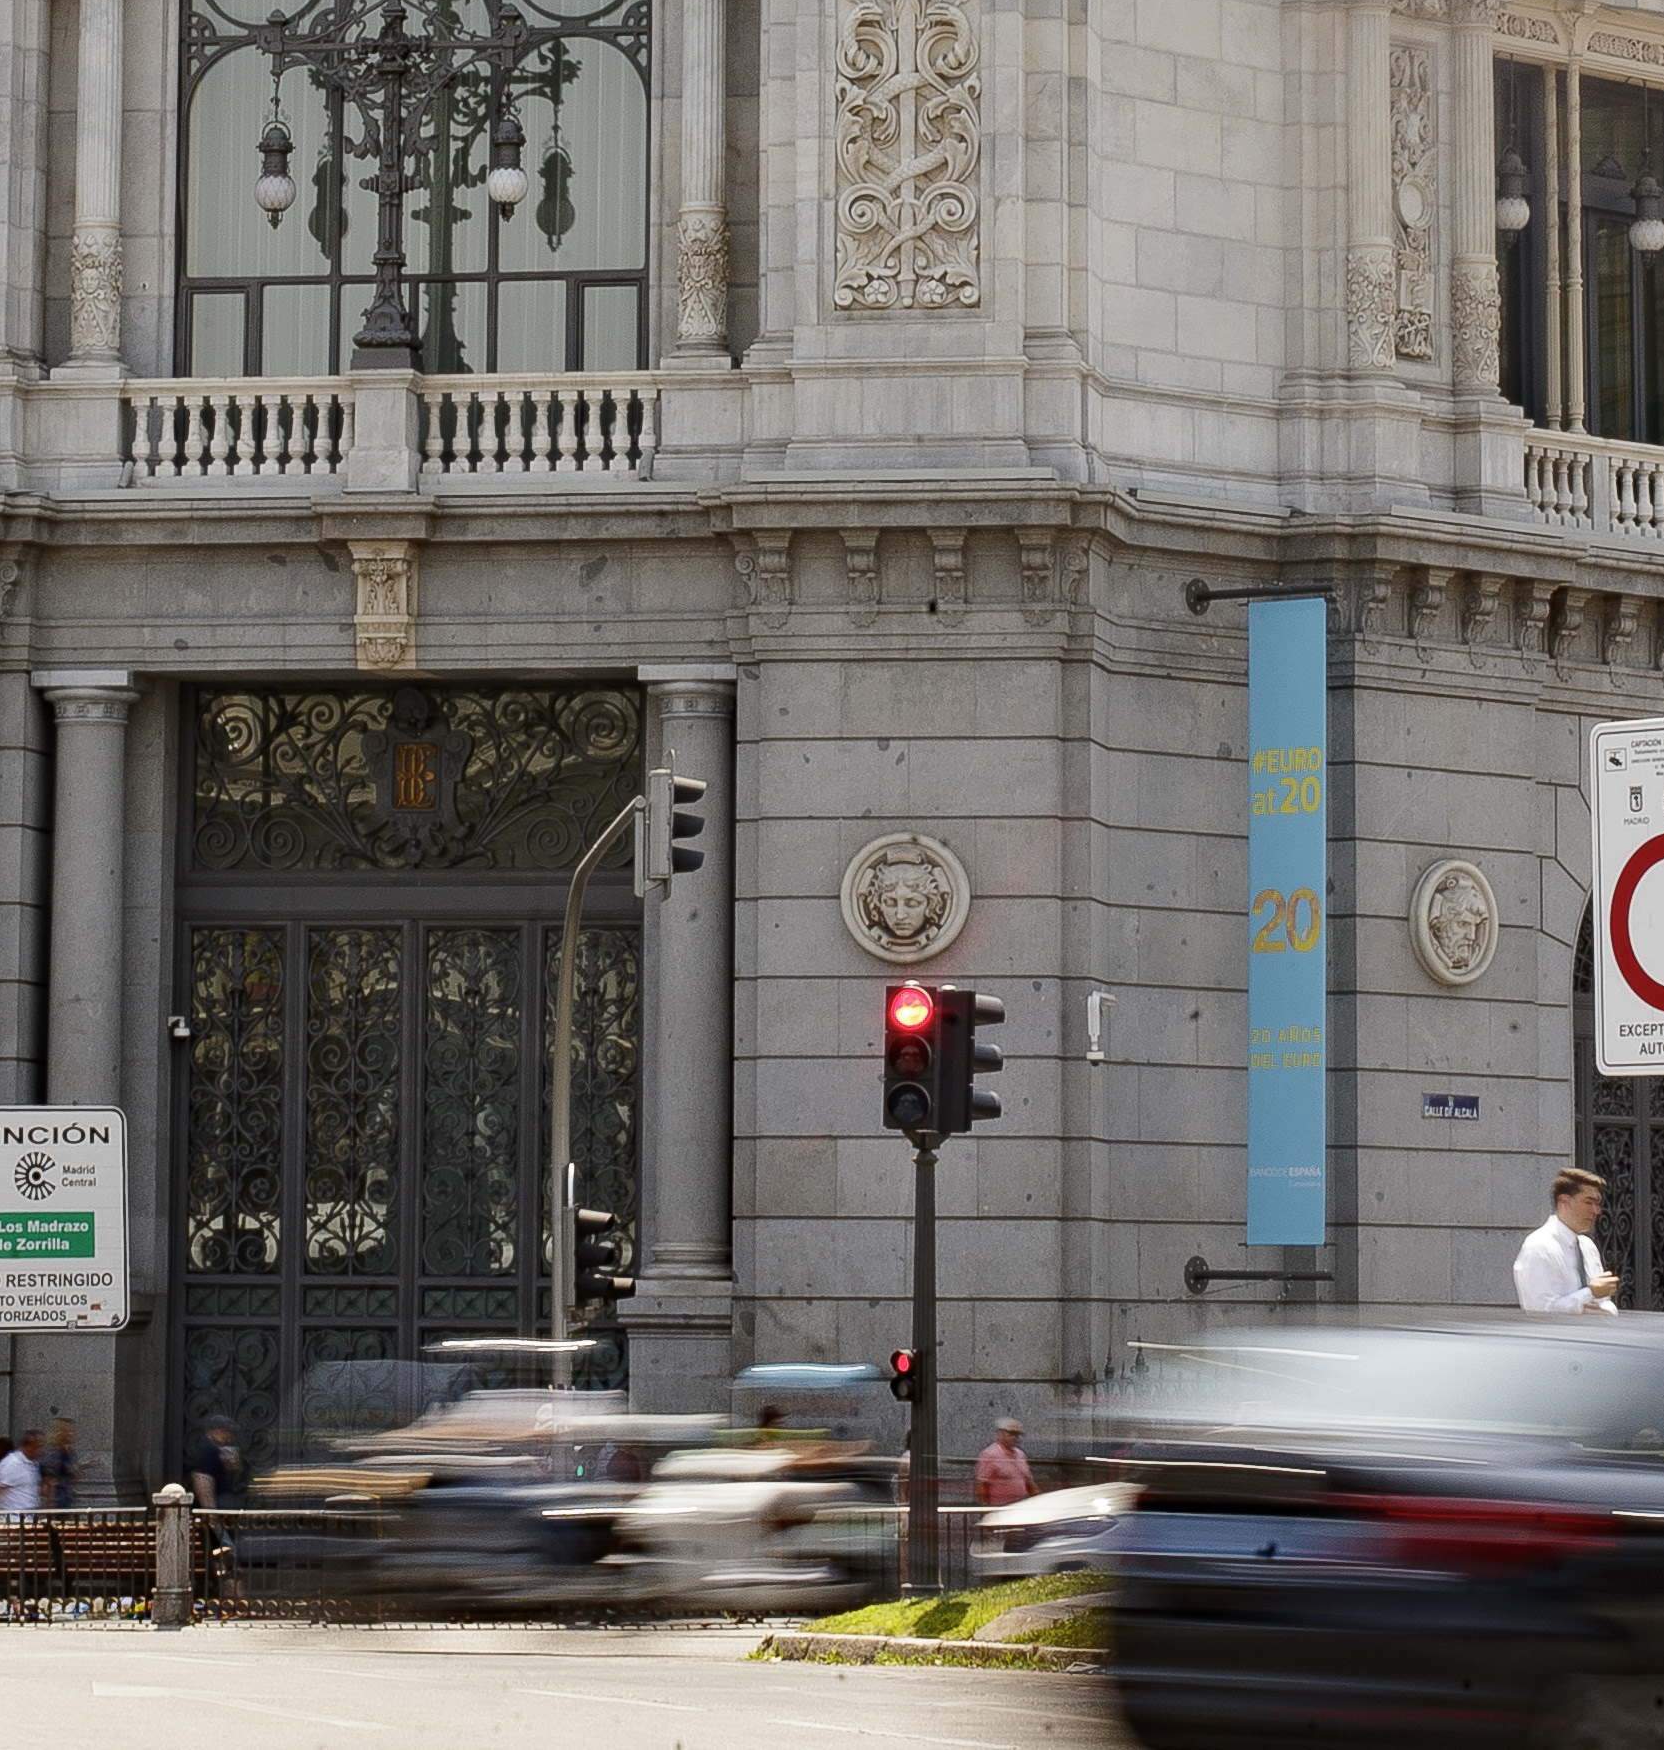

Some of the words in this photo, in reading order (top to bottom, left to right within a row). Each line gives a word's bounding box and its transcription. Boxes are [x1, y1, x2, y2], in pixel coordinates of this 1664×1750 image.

[1252, 747, 1322, 773] #EURO
[1279, 776, 1321, 814] 20
[1252, 887, 1321, 953] 20
[63, 1165, 96, 1174] Madrid
[62, 1178, 97, 1187] Central
[28, 1220, 89, 1233] Madrazo
[16, 1238, 70, 1251] Zorrilla
[6, 1272, 113, 1288] RESTRINGIDO
[19, 1293, 88, 1306] VEHÍCULOS
